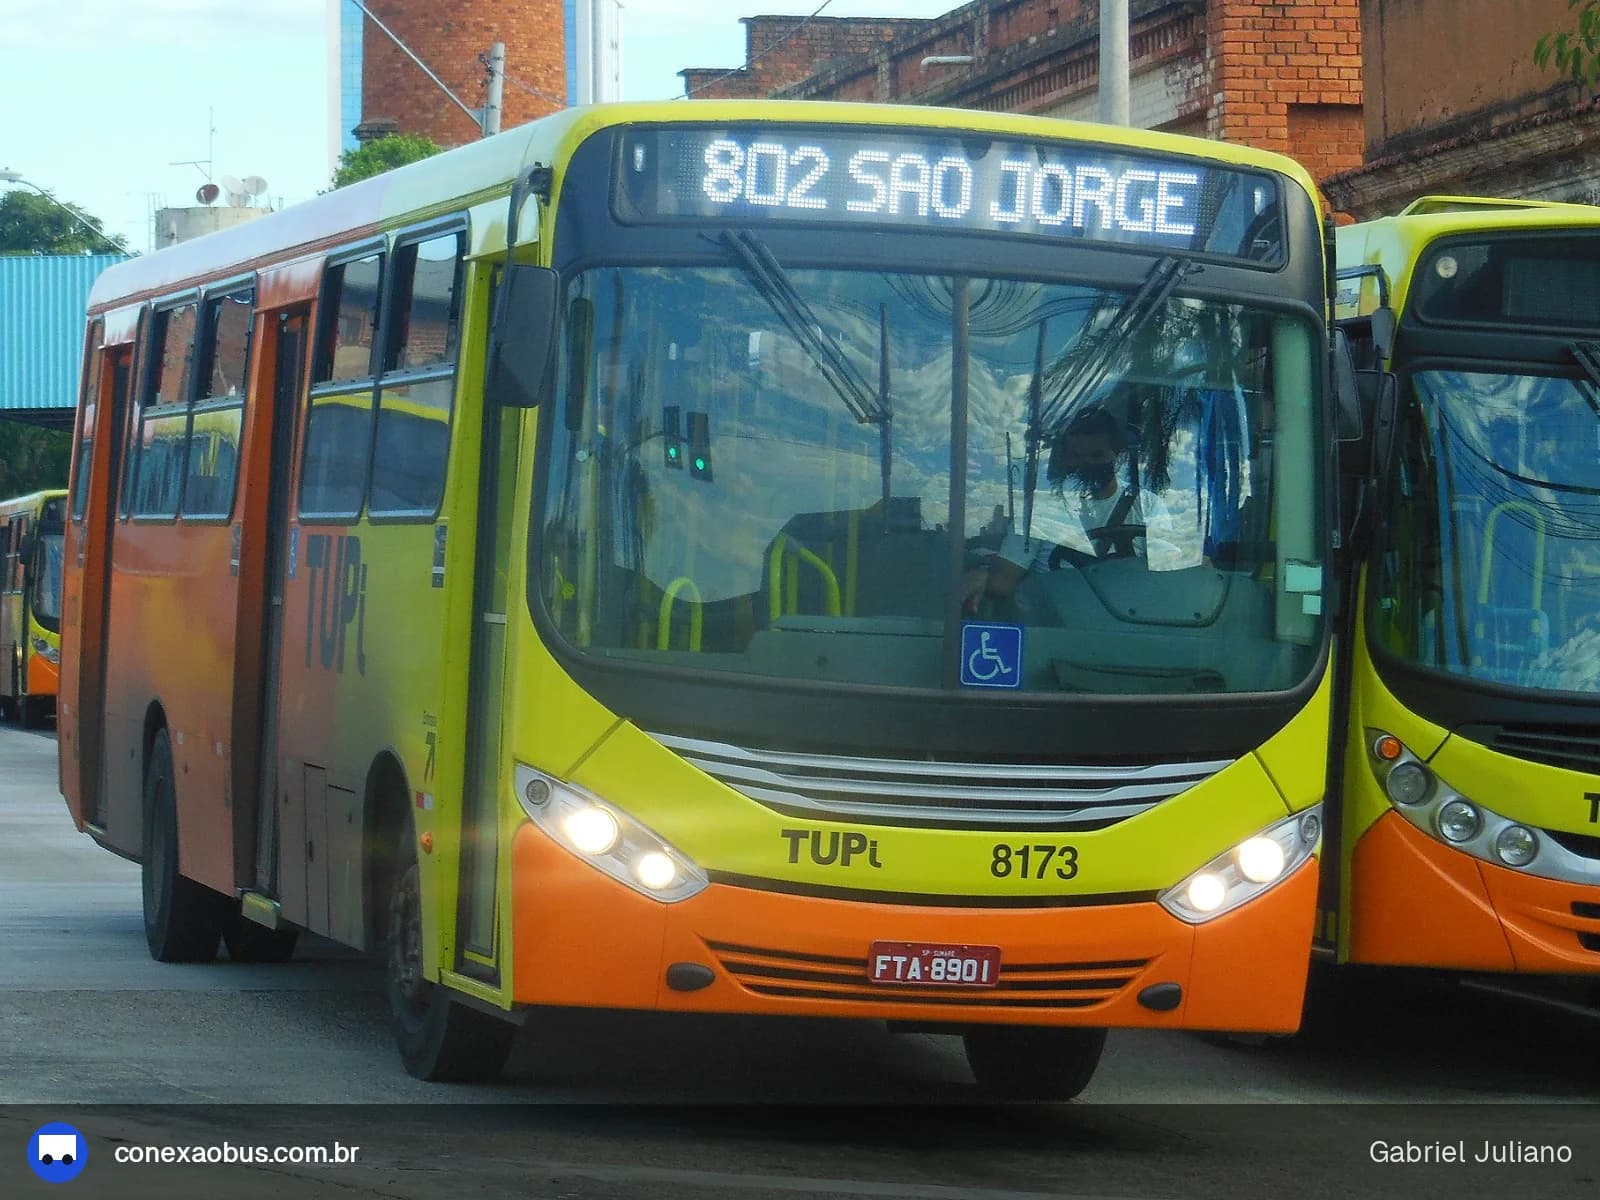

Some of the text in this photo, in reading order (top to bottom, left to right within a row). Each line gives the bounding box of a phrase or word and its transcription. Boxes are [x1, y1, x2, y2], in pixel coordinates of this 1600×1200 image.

[702, 139, 1198, 235] 802 SAO JORGE
[990, 844, 1078, 880] 8173
